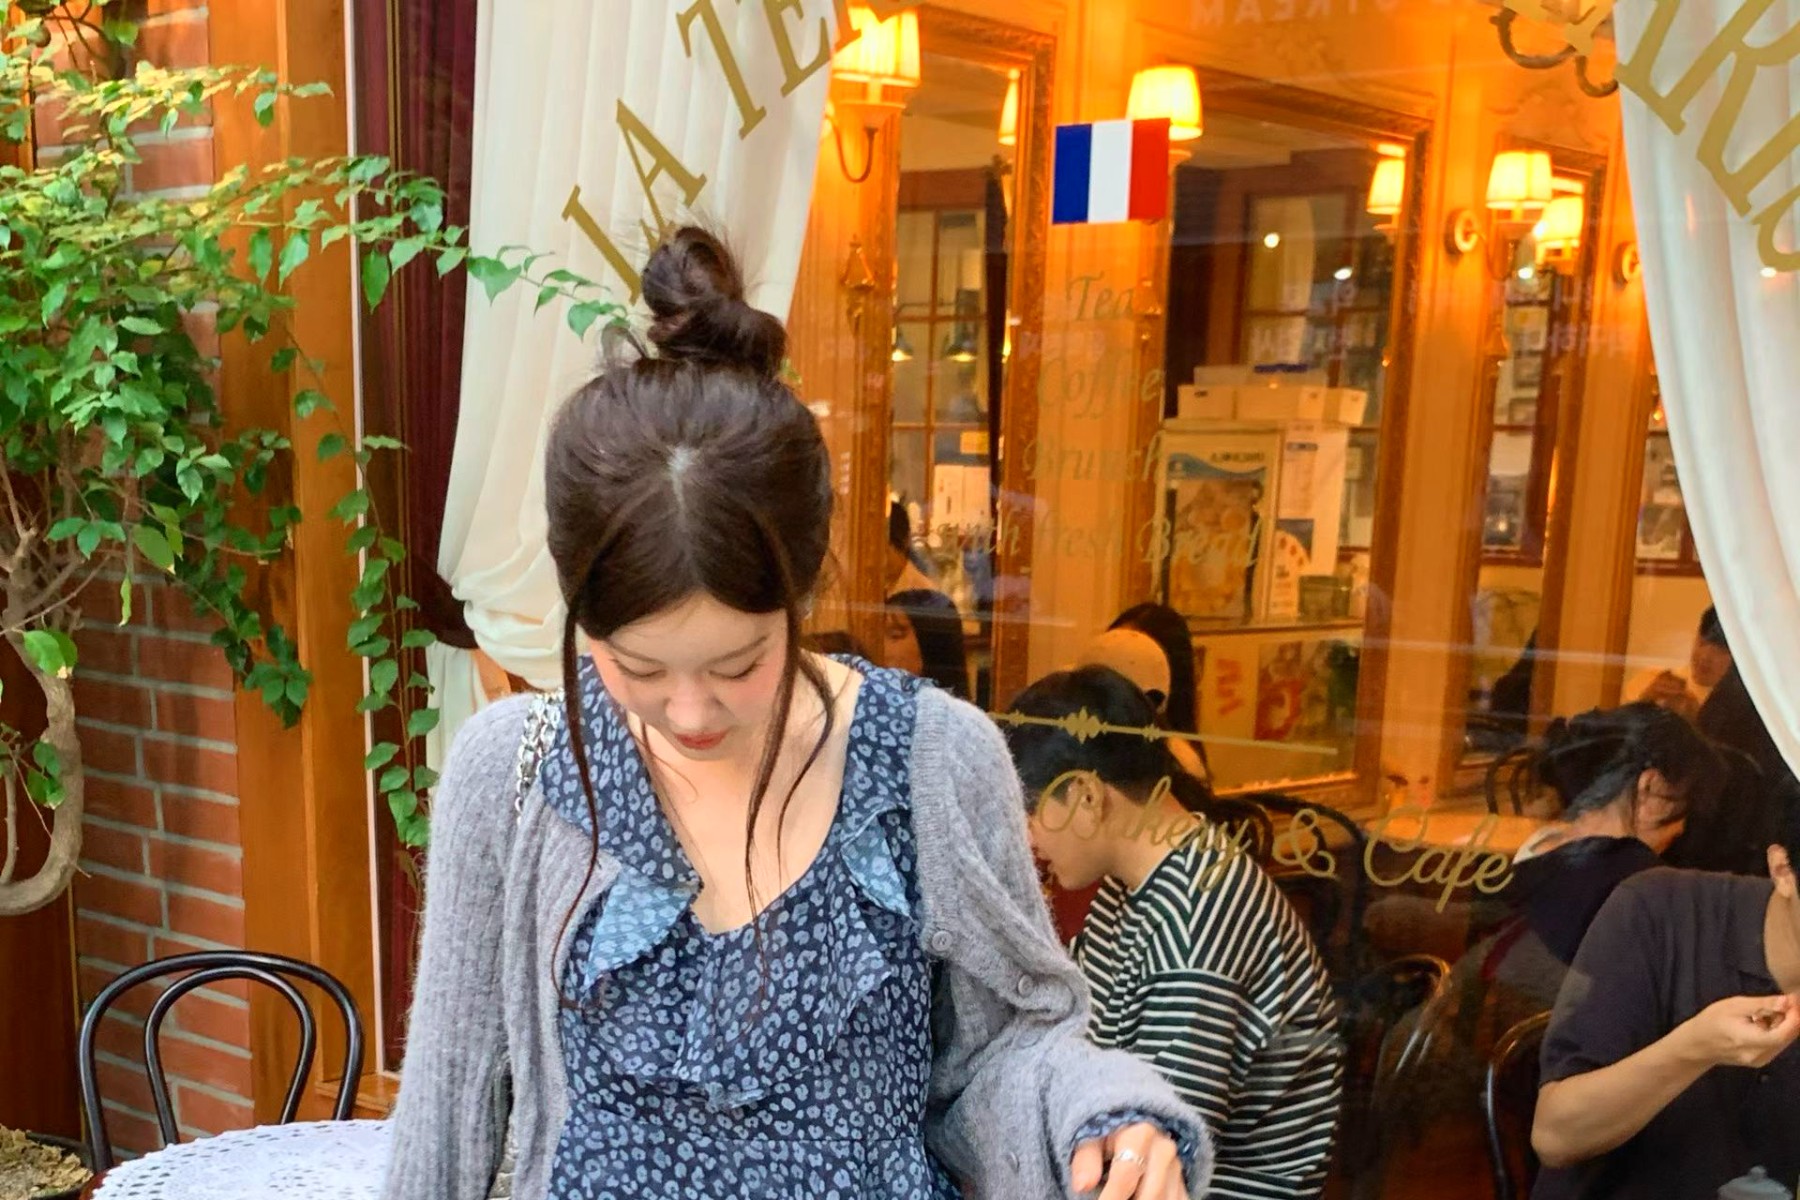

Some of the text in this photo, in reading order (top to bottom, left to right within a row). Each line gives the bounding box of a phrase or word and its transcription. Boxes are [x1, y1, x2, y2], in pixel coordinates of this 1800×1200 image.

[1066, 270, 1136, 322] Tea
[1035, 769, 1253, 892] Bakery
[1271, 807, 1338, 881] &
